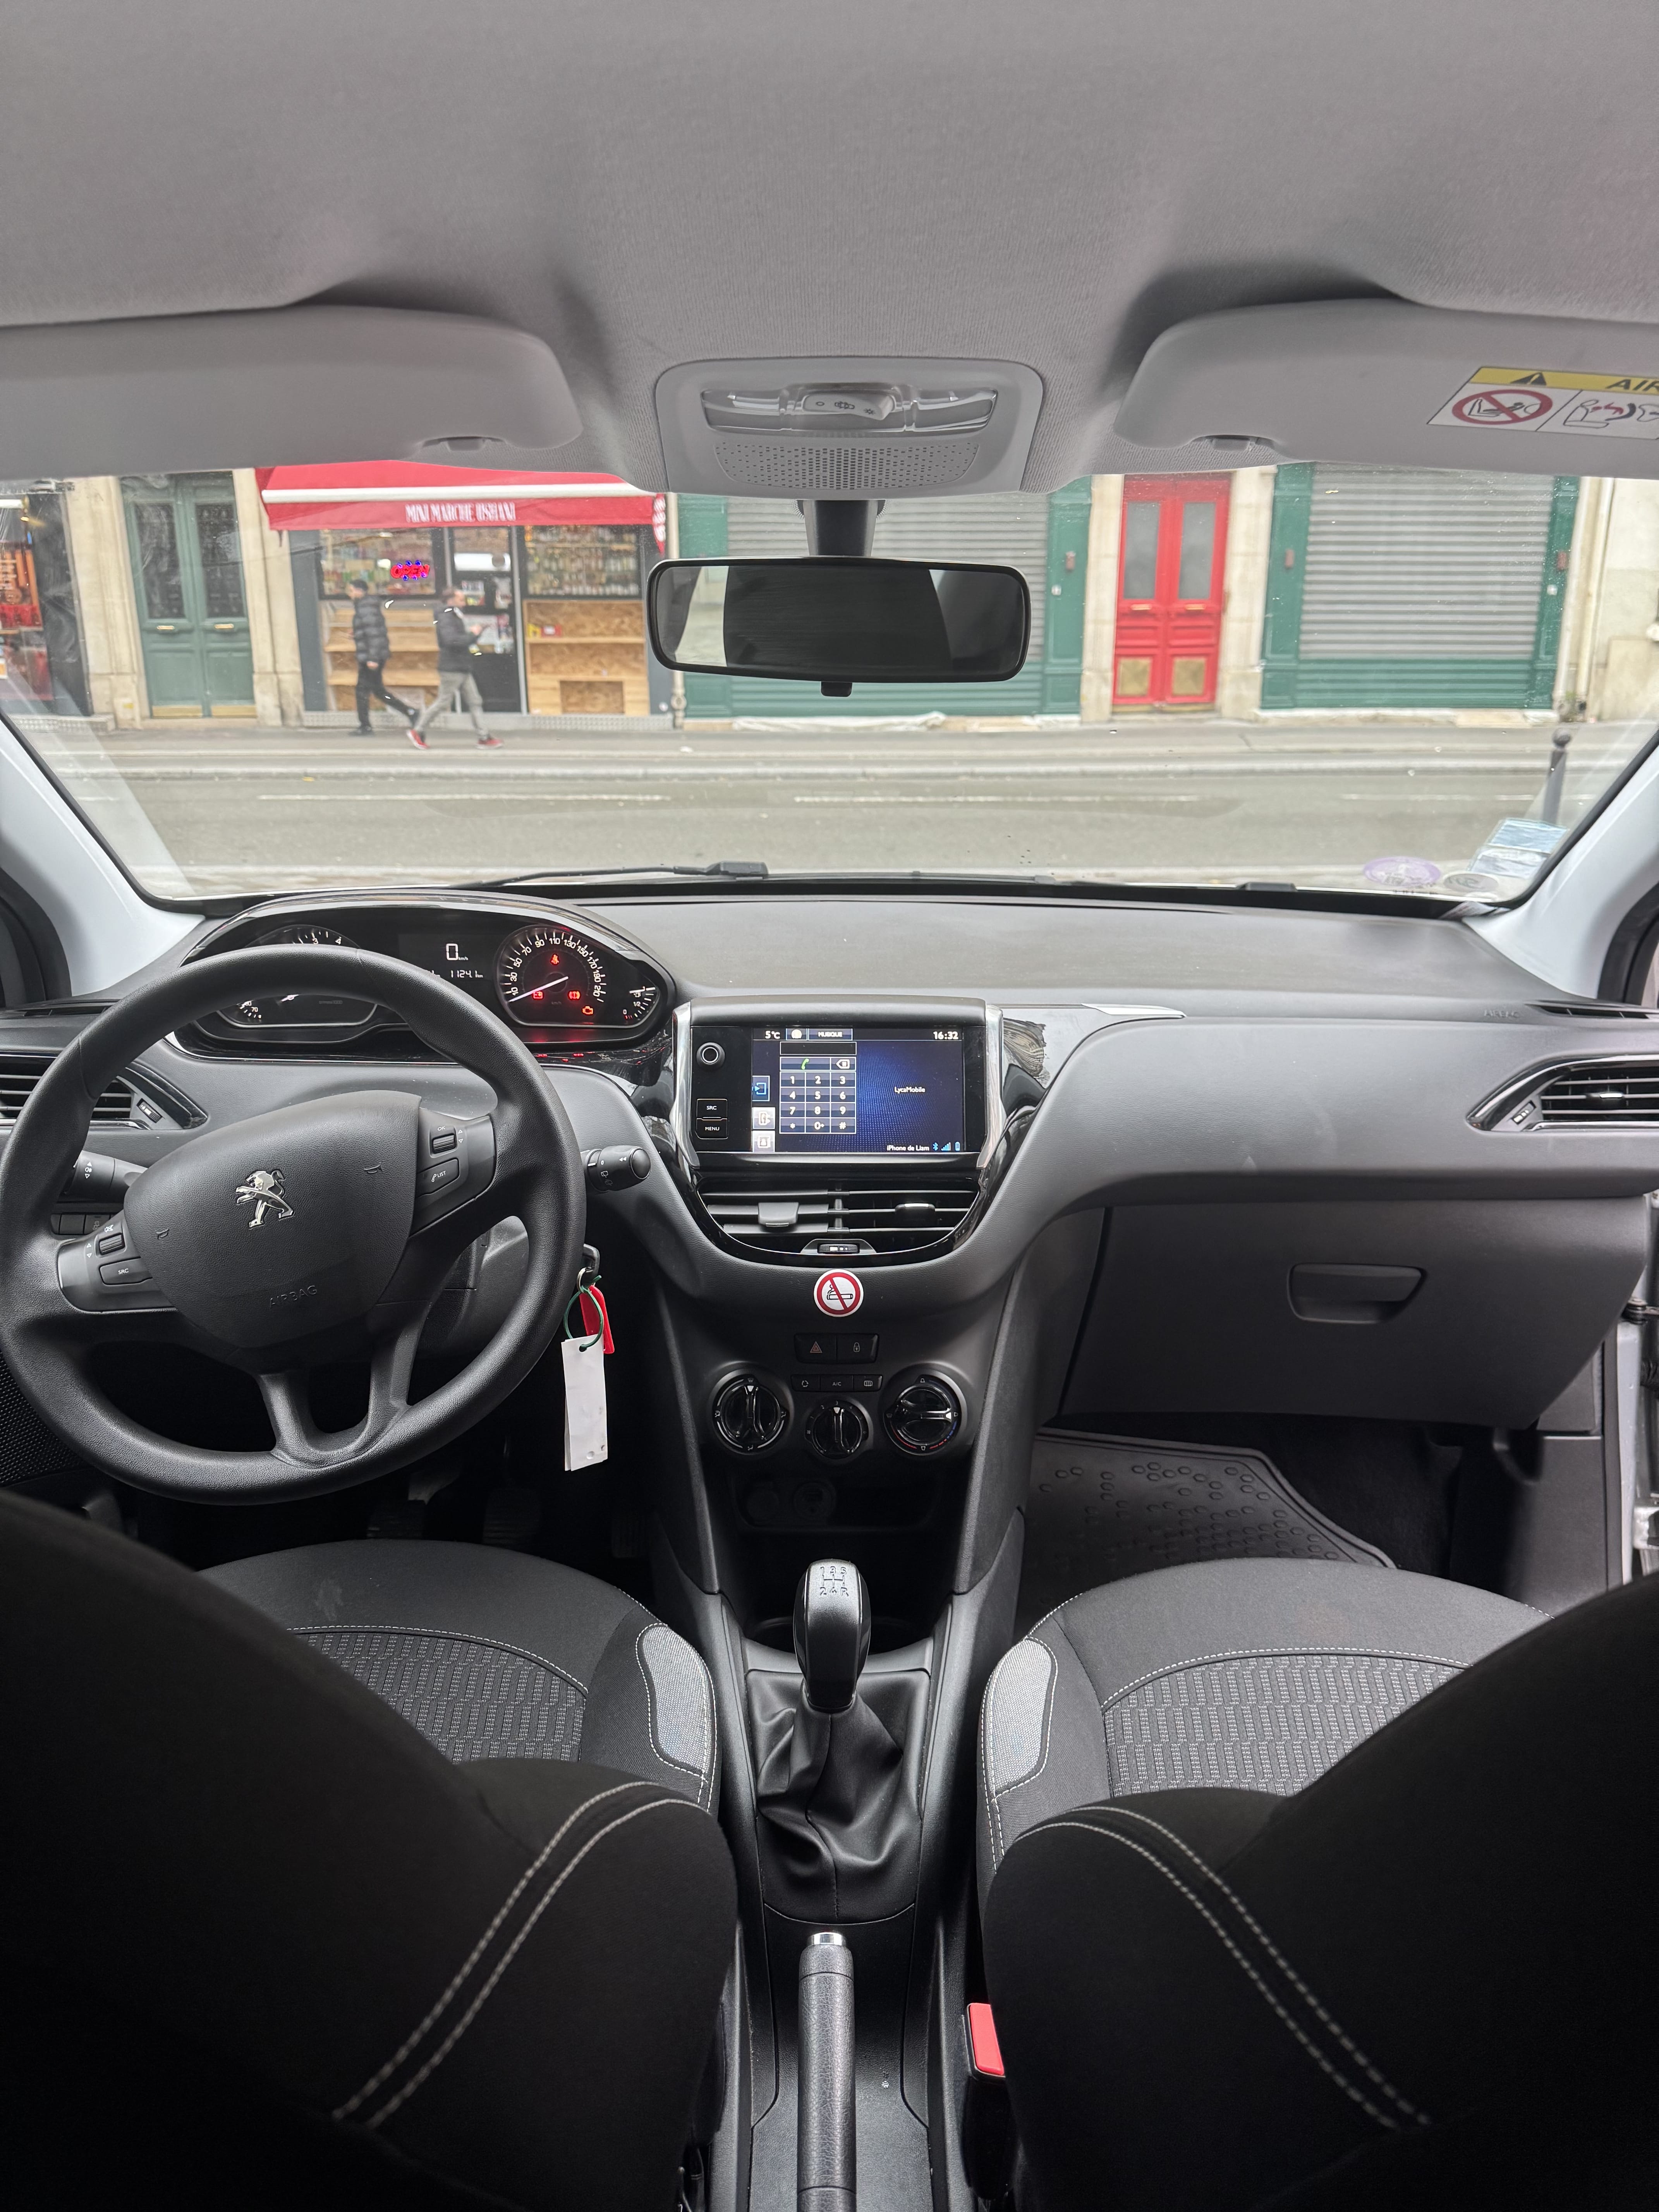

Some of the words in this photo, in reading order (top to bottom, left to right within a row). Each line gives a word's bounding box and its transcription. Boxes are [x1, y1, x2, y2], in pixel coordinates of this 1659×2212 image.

[390, 564, 430, 579] OPEN
[535, 939, 545, 948] 90
[564, 939, 576, 949] 130
[446, 943, 459, 961] 0
[522, 946, 532, 956] 70
[577, 945, 589, 957] 150
[514, 958, 522, 967] 50
[587, 957, 598, 969] 170
[510, 972, 517, 982] 30
[593, 970, 601, 982] 190
[511, 987, 519, 996] 10
[593, 985, 601, 997] 210
[933, 1031, 958, 1039] 16:32
[790, 1076, 795, 1084] 1
[815, 1076, 821, 1084] 2
[840, 1076, 845, 1084] 3
[790, 1091, 796, 1099] 4
[815, 1091, 821, 1099] 5
[840, 1091, 846, 1099] 6
[790, 1106, 795, 1115] 7
[814, 1106, 821, 1115] 8
[840, 1106, 846, 1115] 9
[820, 1587, 827, 1596] 2
[830, 1586, 836, 1595] 4
[840, 1587, 849, 1597] R
